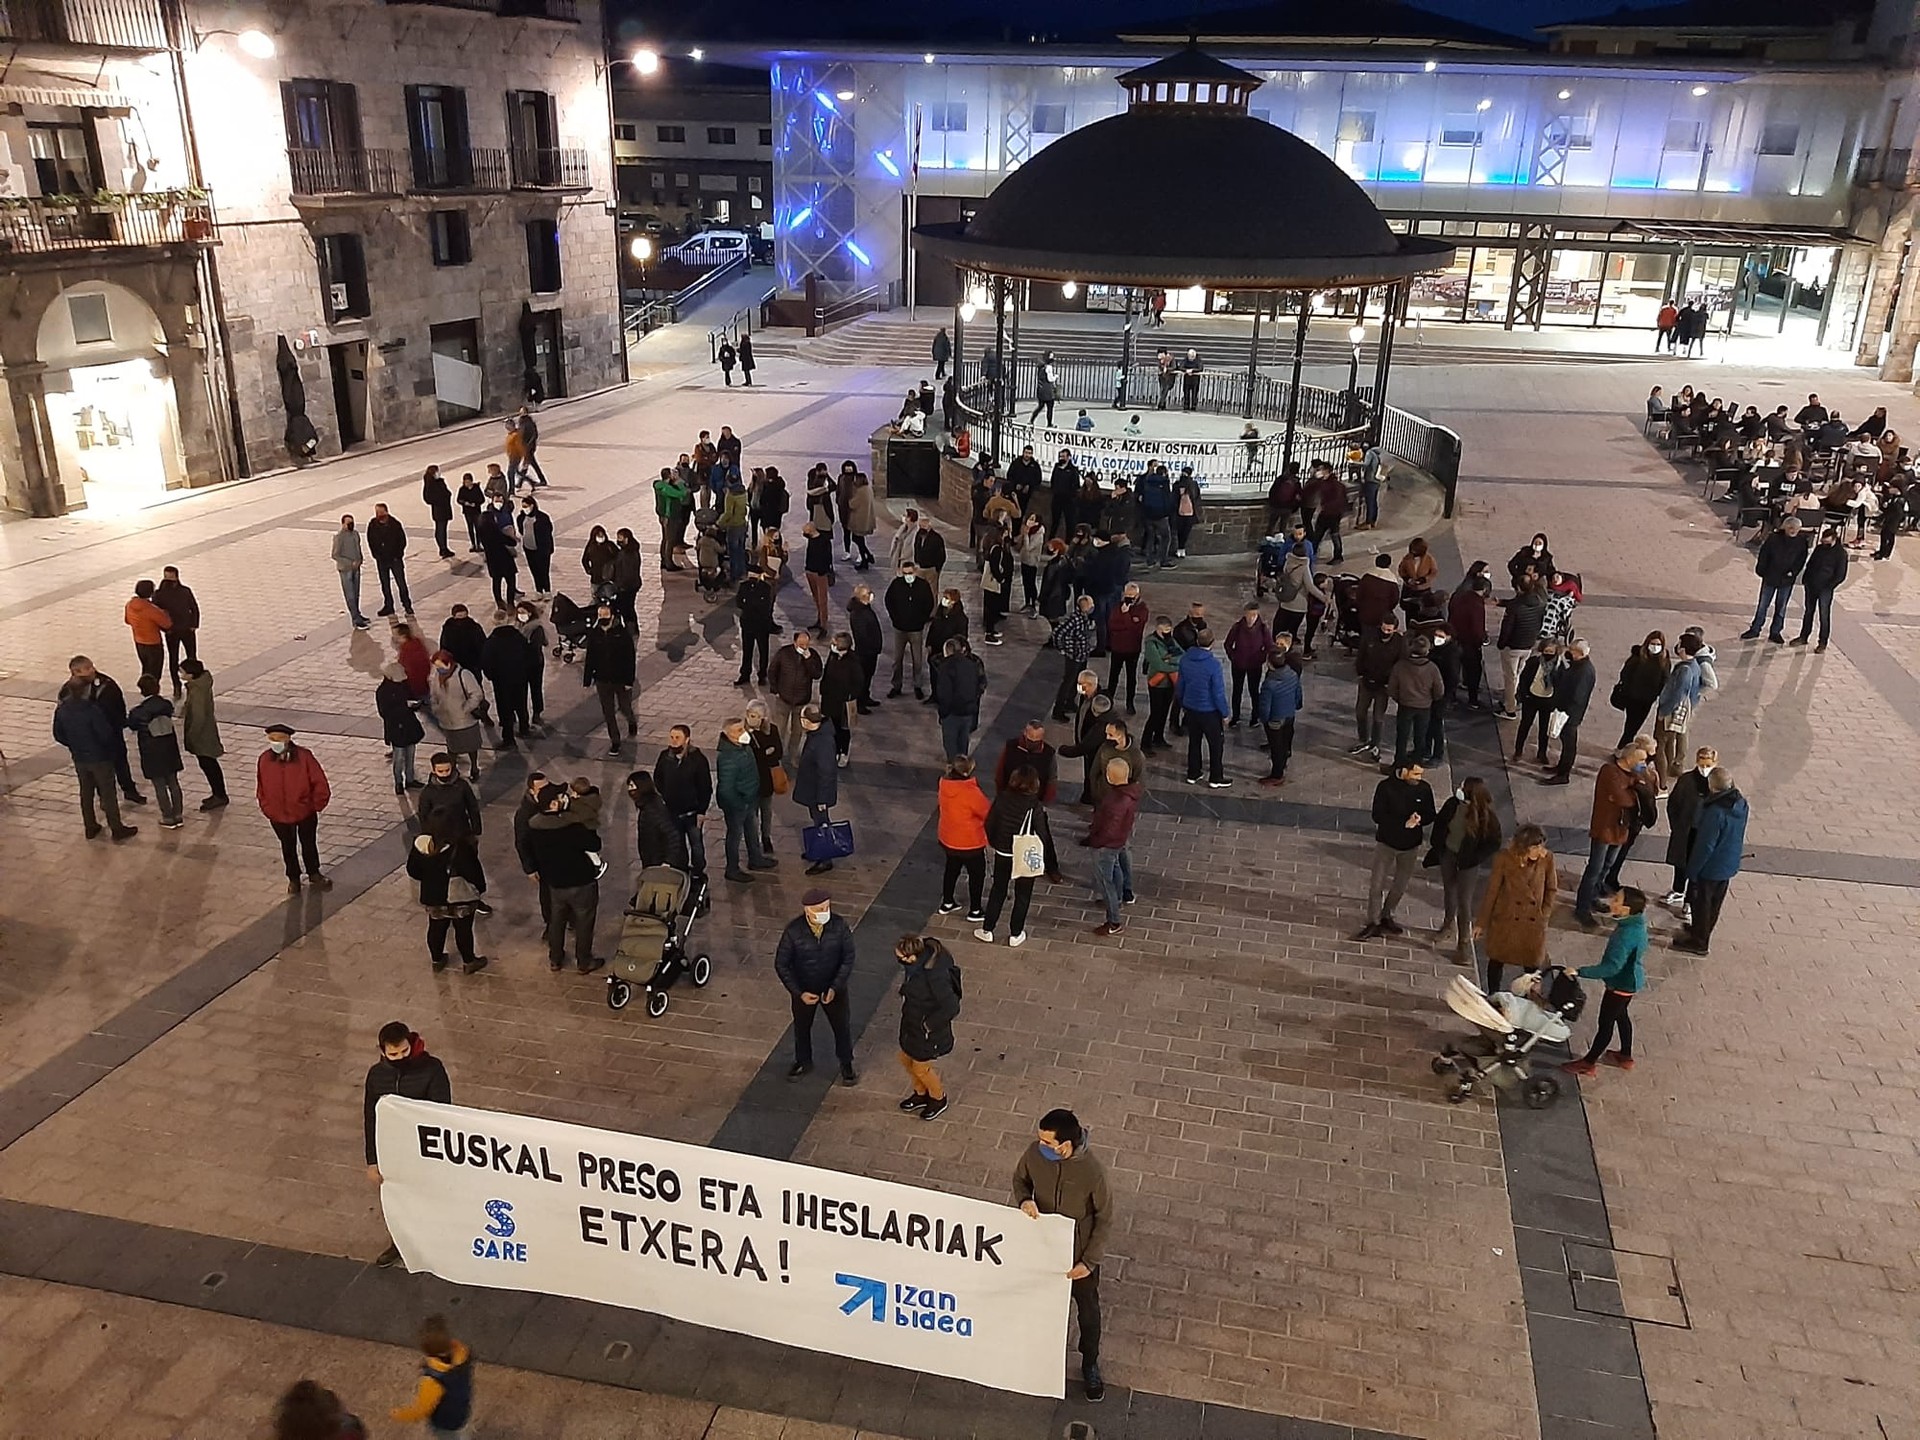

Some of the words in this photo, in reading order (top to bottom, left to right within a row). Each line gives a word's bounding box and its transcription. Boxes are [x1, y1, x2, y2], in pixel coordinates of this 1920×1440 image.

[1043, 431, 1096, 449] OTSAILAK
[1121, 440, 1160, 454] AZKEN
[1165, 443, 1218, 456] OSTIRALA
[1080, 455, 1098, 468] ETA
[1102, 457, 1145, 471] GOTZON
[1158, 460, 1201, 473] TXERA!
[417, 1125, 563, 1183] EUSKAL
[578, 1152, 682, 1202] PRESO
[699, 1178, 762, 1219] ETA
[782, 1190, 1003, 1266] IHESLARIAK
[473, 1238, 527, 1262] SARE
[579, 1205, 791, 1284] ETXERA!
